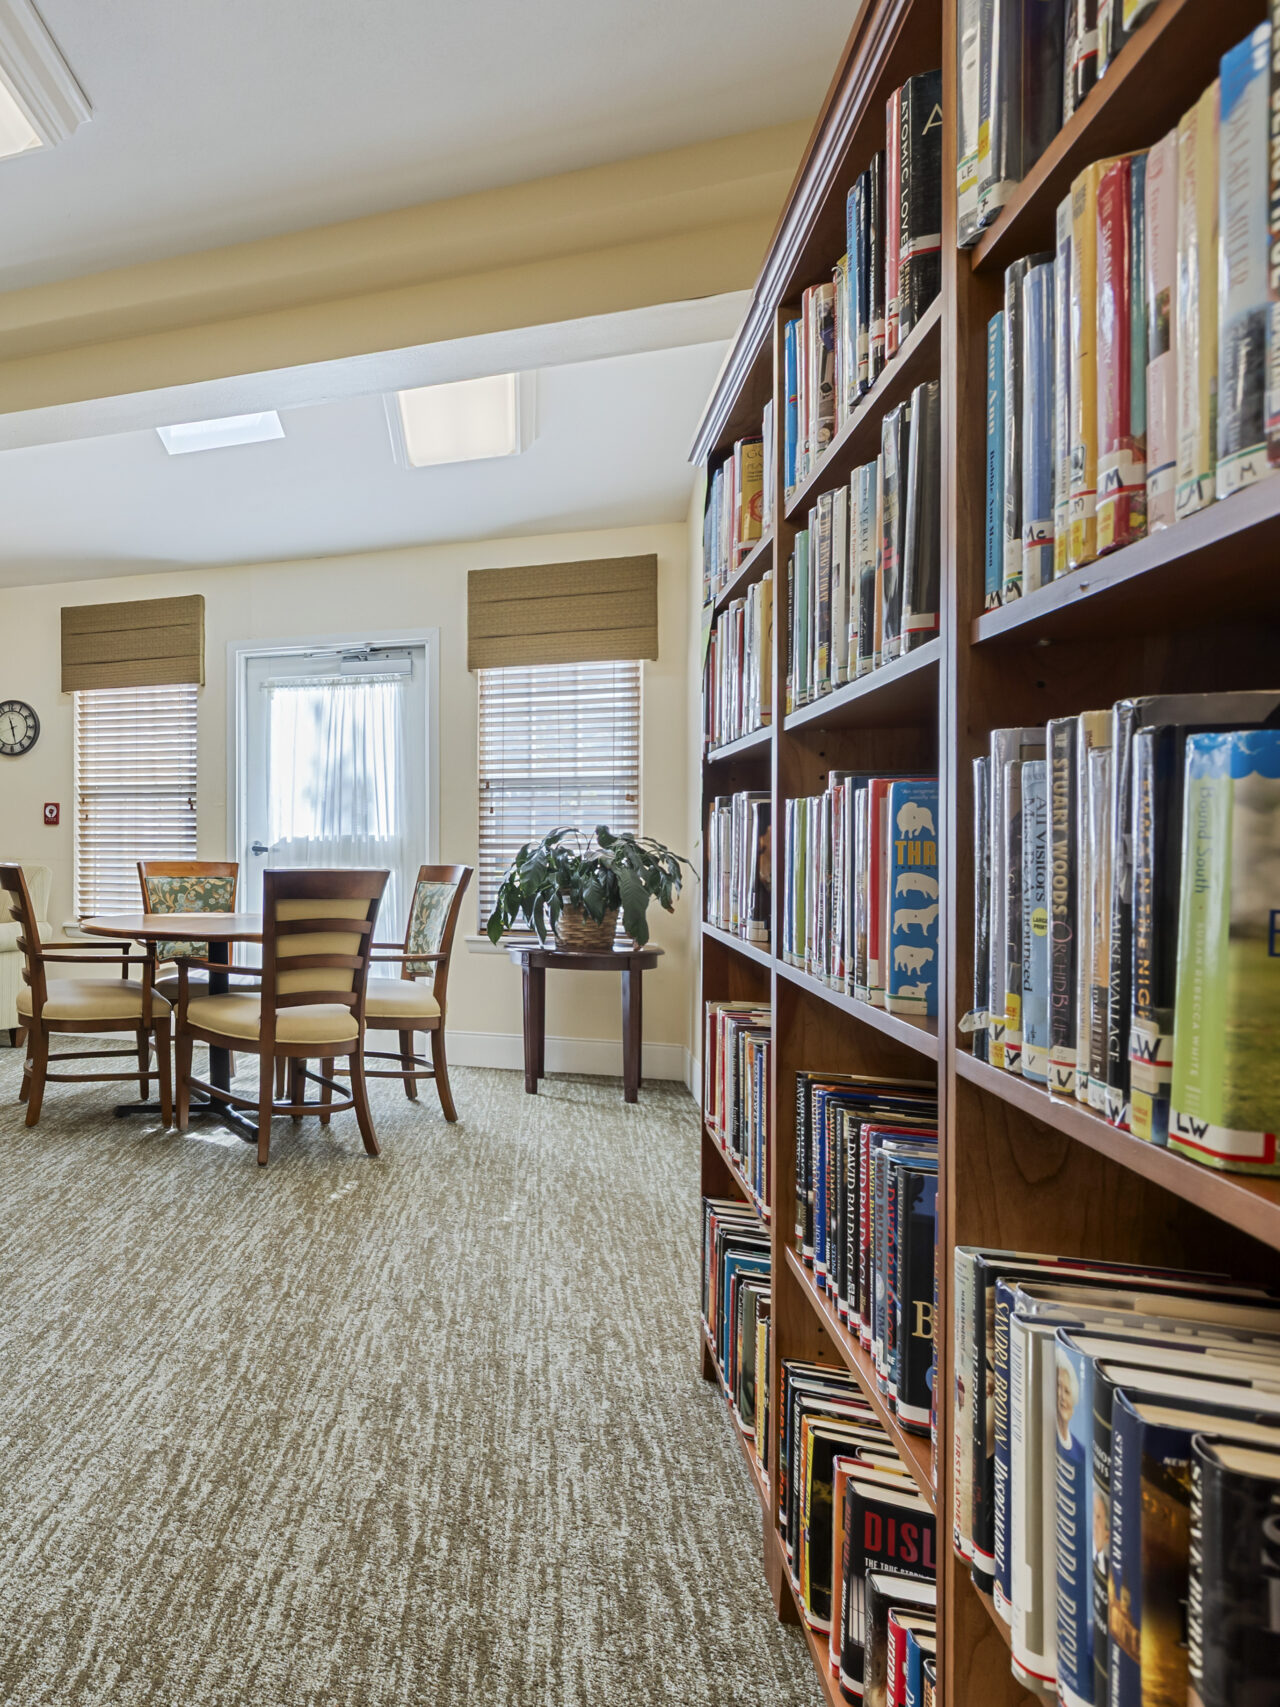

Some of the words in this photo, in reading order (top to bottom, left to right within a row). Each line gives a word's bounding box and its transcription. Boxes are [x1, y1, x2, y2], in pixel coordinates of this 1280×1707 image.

[900, 100, 909, 181] ATOMIC
[899, 187, 910, 250] LOVE
[990, 322, 1000, 383] Dear
[989, 388, 999, 435] Ann
[1035, 793, 1047, 824] All
[1051, 757, 1071, 833] STUART
[1138, 780, 1152, 858] EMMA
[1195, 786, 1215, 841] Bound
[1035, 824, 1047, 904] Visitors
[1051, 837, 1070, 917] WOODS
[1137, 866, 1151, 894] IN
[1194, 848, 1212, 895] South
[1023, 876, 1034, 993] Announced
[1051, 919, 1073, 992] ORCHID
[1110, 911, 1122, 962] MIKE
[1136, 903, 1151, 950] THE
[1194, 921, 1204, 965] SUSAN
[1050, 992, 1070, 1049] BLUES
[1109, 967, 1122, 1062] WALLACE
[1192, 969, 1203, 1030] REBECCA
[1189, 1034, 1200, 1077] WHITE
[847, 1141, 857, 1190] DAVID
[860, 1130, 869, 1190] DAVID
[847, 1191, 857, 1272] BALDACCI
[860, 1190, 868, 1286] BALDACCI
[887, 1186, 896, 1249] DAVID
[887, 1251, 896, 1351] BALDACCI
[911, 1300, 934, 1339] B
[994, 1302, 1010, 1371] SANDRA
[994, 1370, 1010, 1451] BROWN
[955, 1434, 963, 1475] FIRST
[1113, 1431, 1124, 1497] STEVE
[954, 1478, 962, 1532] LADIES
[993, 1454, 1008, 1572] UNSPEAKABLE
[1055, 1454, 1076, 1587] BARBARA
[1112, 1499, 1124, 1571] BERRY
[864, 1510, 937, 1570] DISL
[864, 1556, 879, 1570] THE
[887, 1628, 896, 1684] JEFFERY
[1056, 1589, 1078, 1676] BUSH
